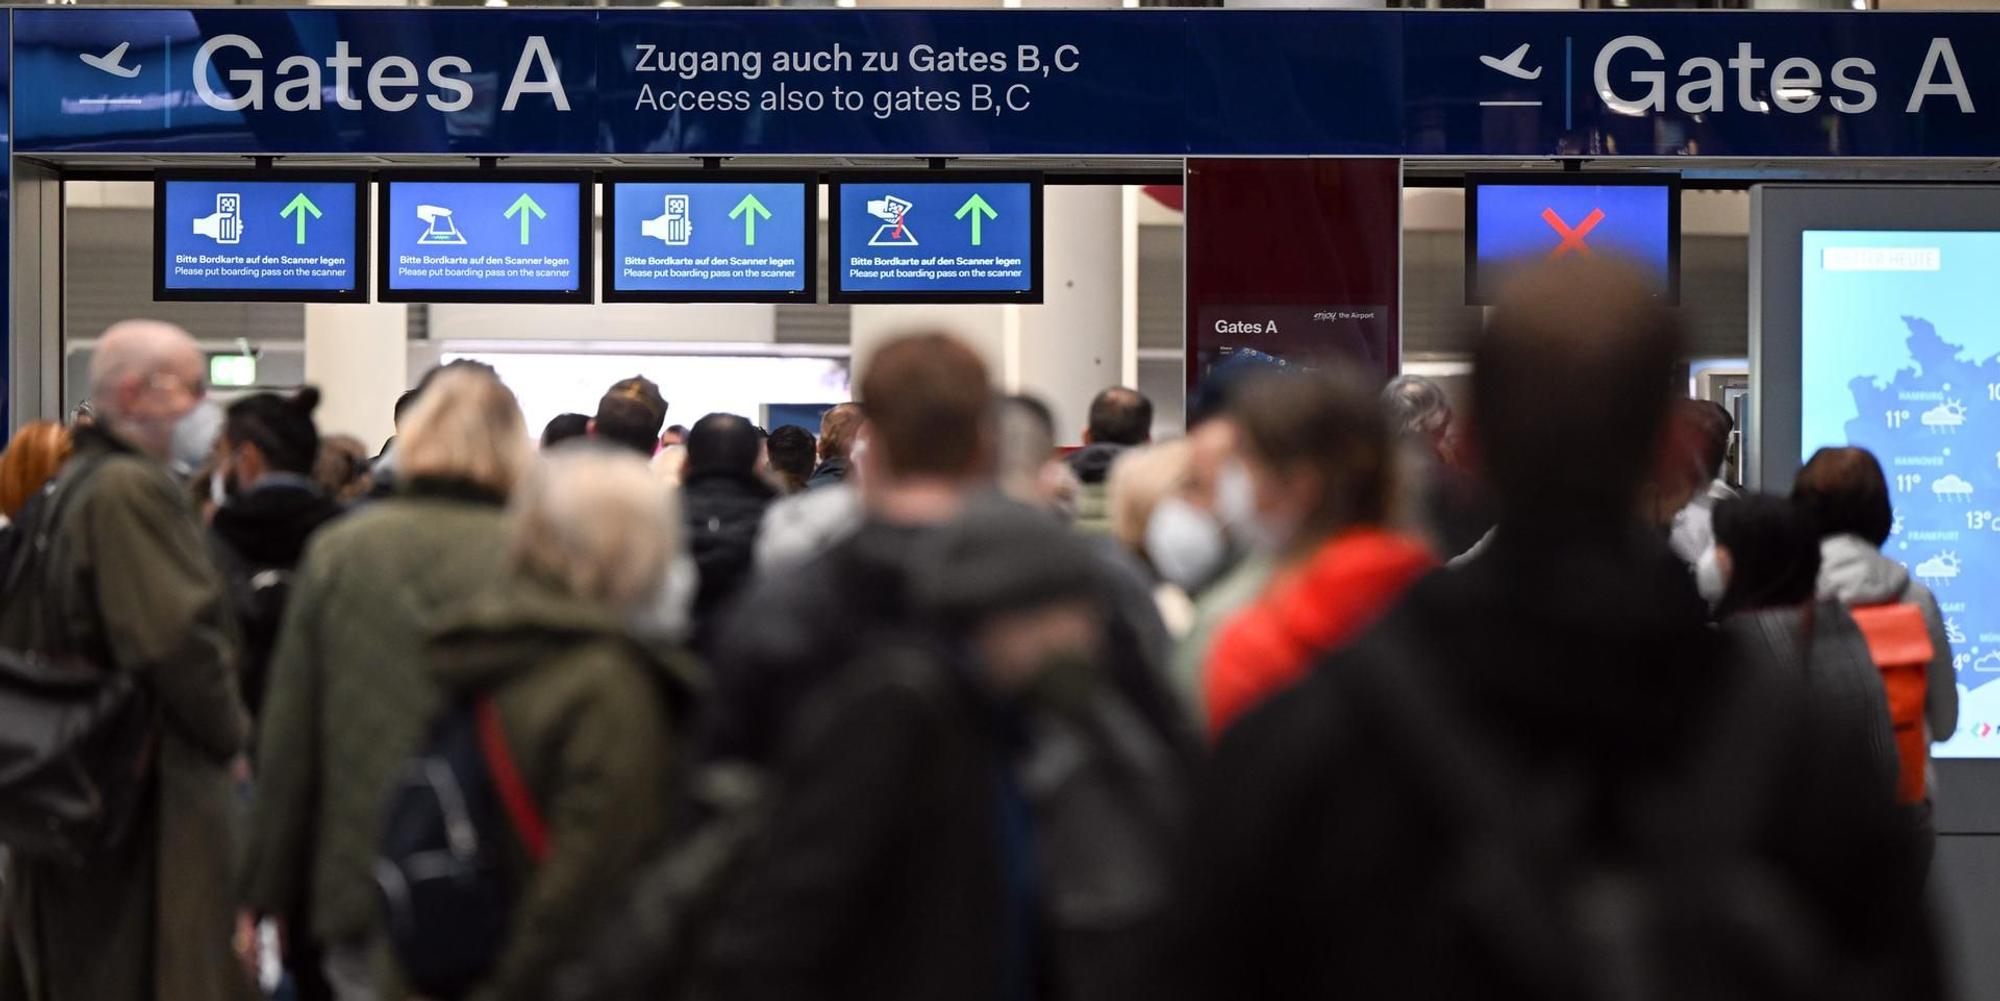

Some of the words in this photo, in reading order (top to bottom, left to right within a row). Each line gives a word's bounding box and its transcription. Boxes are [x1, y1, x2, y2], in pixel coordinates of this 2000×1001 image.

[635, 44, 762, 80] Zugang
[772, 43, 852, 72] auch
[861, 51, 898, 72] zu
[908, 44, 1007, 72] Gates
[190, 34, 474, 113] Gates
[501, 35, 571, 112] A
[1593, 35, 1878, 115] Gates
[1905, 37, 1976, 114] A
[635, 83, 751, 112] Access
[760, 82, 824, 112] also
[831, 85, 864, 112] to
[873, 85, 961, 119] gates
[175, 255, 198, 264] Bitte
[198, 255, 245, 264] Bordkarte
[245, 255, 261, 264] auf
[261, 255, 280, 264] den
[280, 255, 319, 264] Scanner
[319, 255, 346, 266] legen
[399, 256, 422, 265] Bitte
[422, 256, 469, 265] Bordkarte
[469, 256, 485, 265] auf
[485, 256, 504, 265] den
[504, 256, 543, 265] Scanner
[543, 256, 569, 267] legen
[624, 256, 647, 265] Bitte
[647, 256, 694, 265] Bordkarte
[694, 256, 710, 265] auf
[710, 256, 729, 265] den
[729, 256, 768, 265] Scanner
[768, 256, 795, 267] legen
[850, 256, 873, 265] Bitte
[873, 256, 920, 265] Bordkarte
[920, 256, 936, 265] auf
[936, 256, 955, 265] den
[955, 256, 995, 265] Scanner
[995, 256, 1021, 267] legen
[174, 267, 204, 276] Please
[204, 269, 220, 278] put
[220, 267, 260, 279] boarding
[261, 270, 282, 279] pass
[282, 269, 295, 277] on
[295, 268, 311, 277] the
[311, 269, 347, 278] scanner
[398, 267, 428, 276] Please
[428, 269, 444, 278] put
[444, 267, 484, 279] boarding
[484, 270, 506, 279] pass
[506, 269, 519, 277] on
[519, 268, 535, 277] the
[535, 269, 570, 278] scanner
[623, 268, 653, 277] Please
[653, 270, 669, 279] put
[669, 268, 710, 280] boarding
[710, 271, 731, 280] pass
[731, 270, 744, 278] on
[744, 269, 760, 278] the
[760, 270, 796, 279] scanner
[849, 268, 879, 277] Please
[879, 270, 895, 279] put
[895, 268, 936, 280] boarding
[936, 271, 958, 280] pass
[958, 270, 971, 278] on
[971, 269, 986, 278] the
[986, 270, 1023, 279] scanner
[1351, 312, 1374, 320] Airport
[1214, 319, 1262, 334] Gates
[1265, 319, 1279, 334] A
